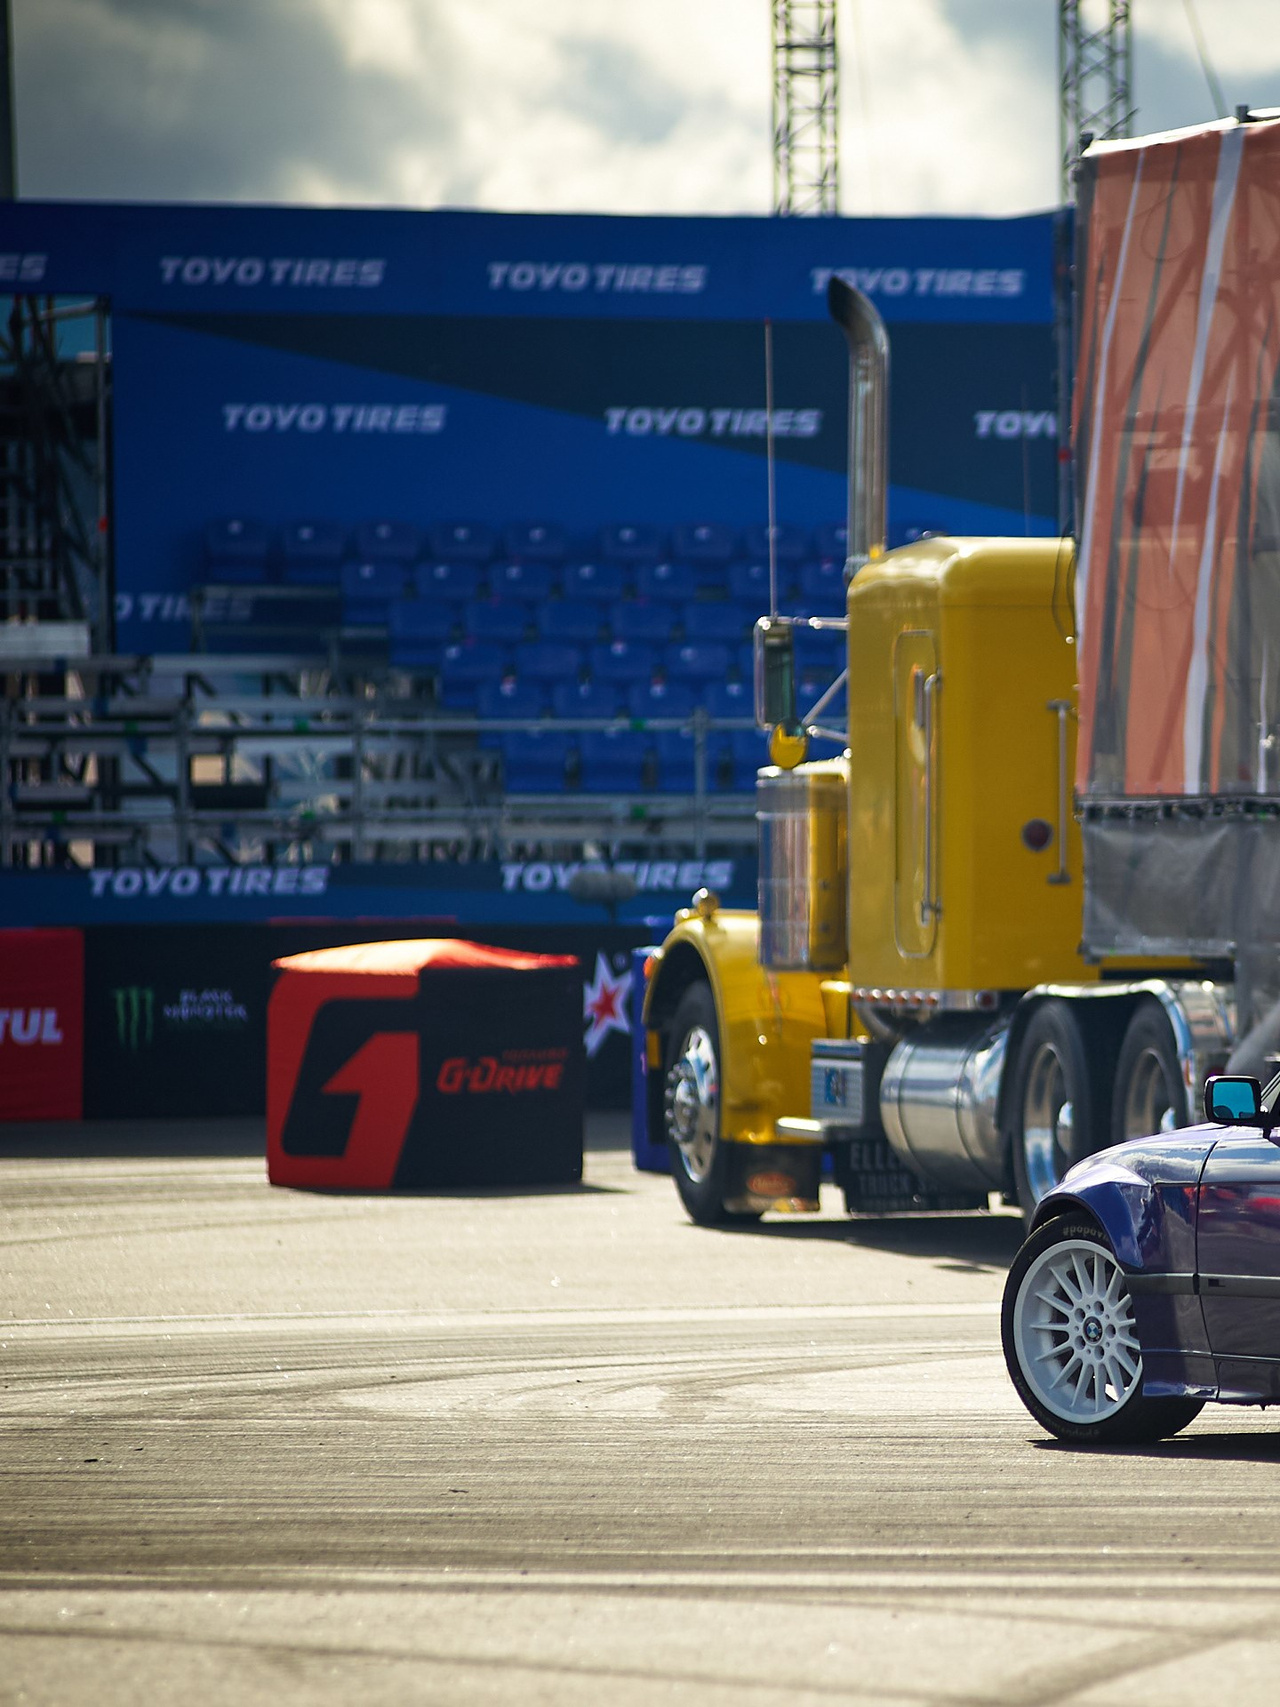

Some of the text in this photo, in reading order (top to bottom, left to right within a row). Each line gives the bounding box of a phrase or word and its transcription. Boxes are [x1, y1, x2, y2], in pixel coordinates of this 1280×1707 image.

[160, 257, 385, 287] TOYO TIRES
[487, 261, 706, 293] TOYO TIRES
[915, 268, 1024, 296] TIRES
[223, 403, 446, 434] TOYO TIRES
[604, 406, 822, 437] TOYO TIRES
[89, 867, 329, 896] TOYO TIRES
[501, 861, 609, 892] TOY
